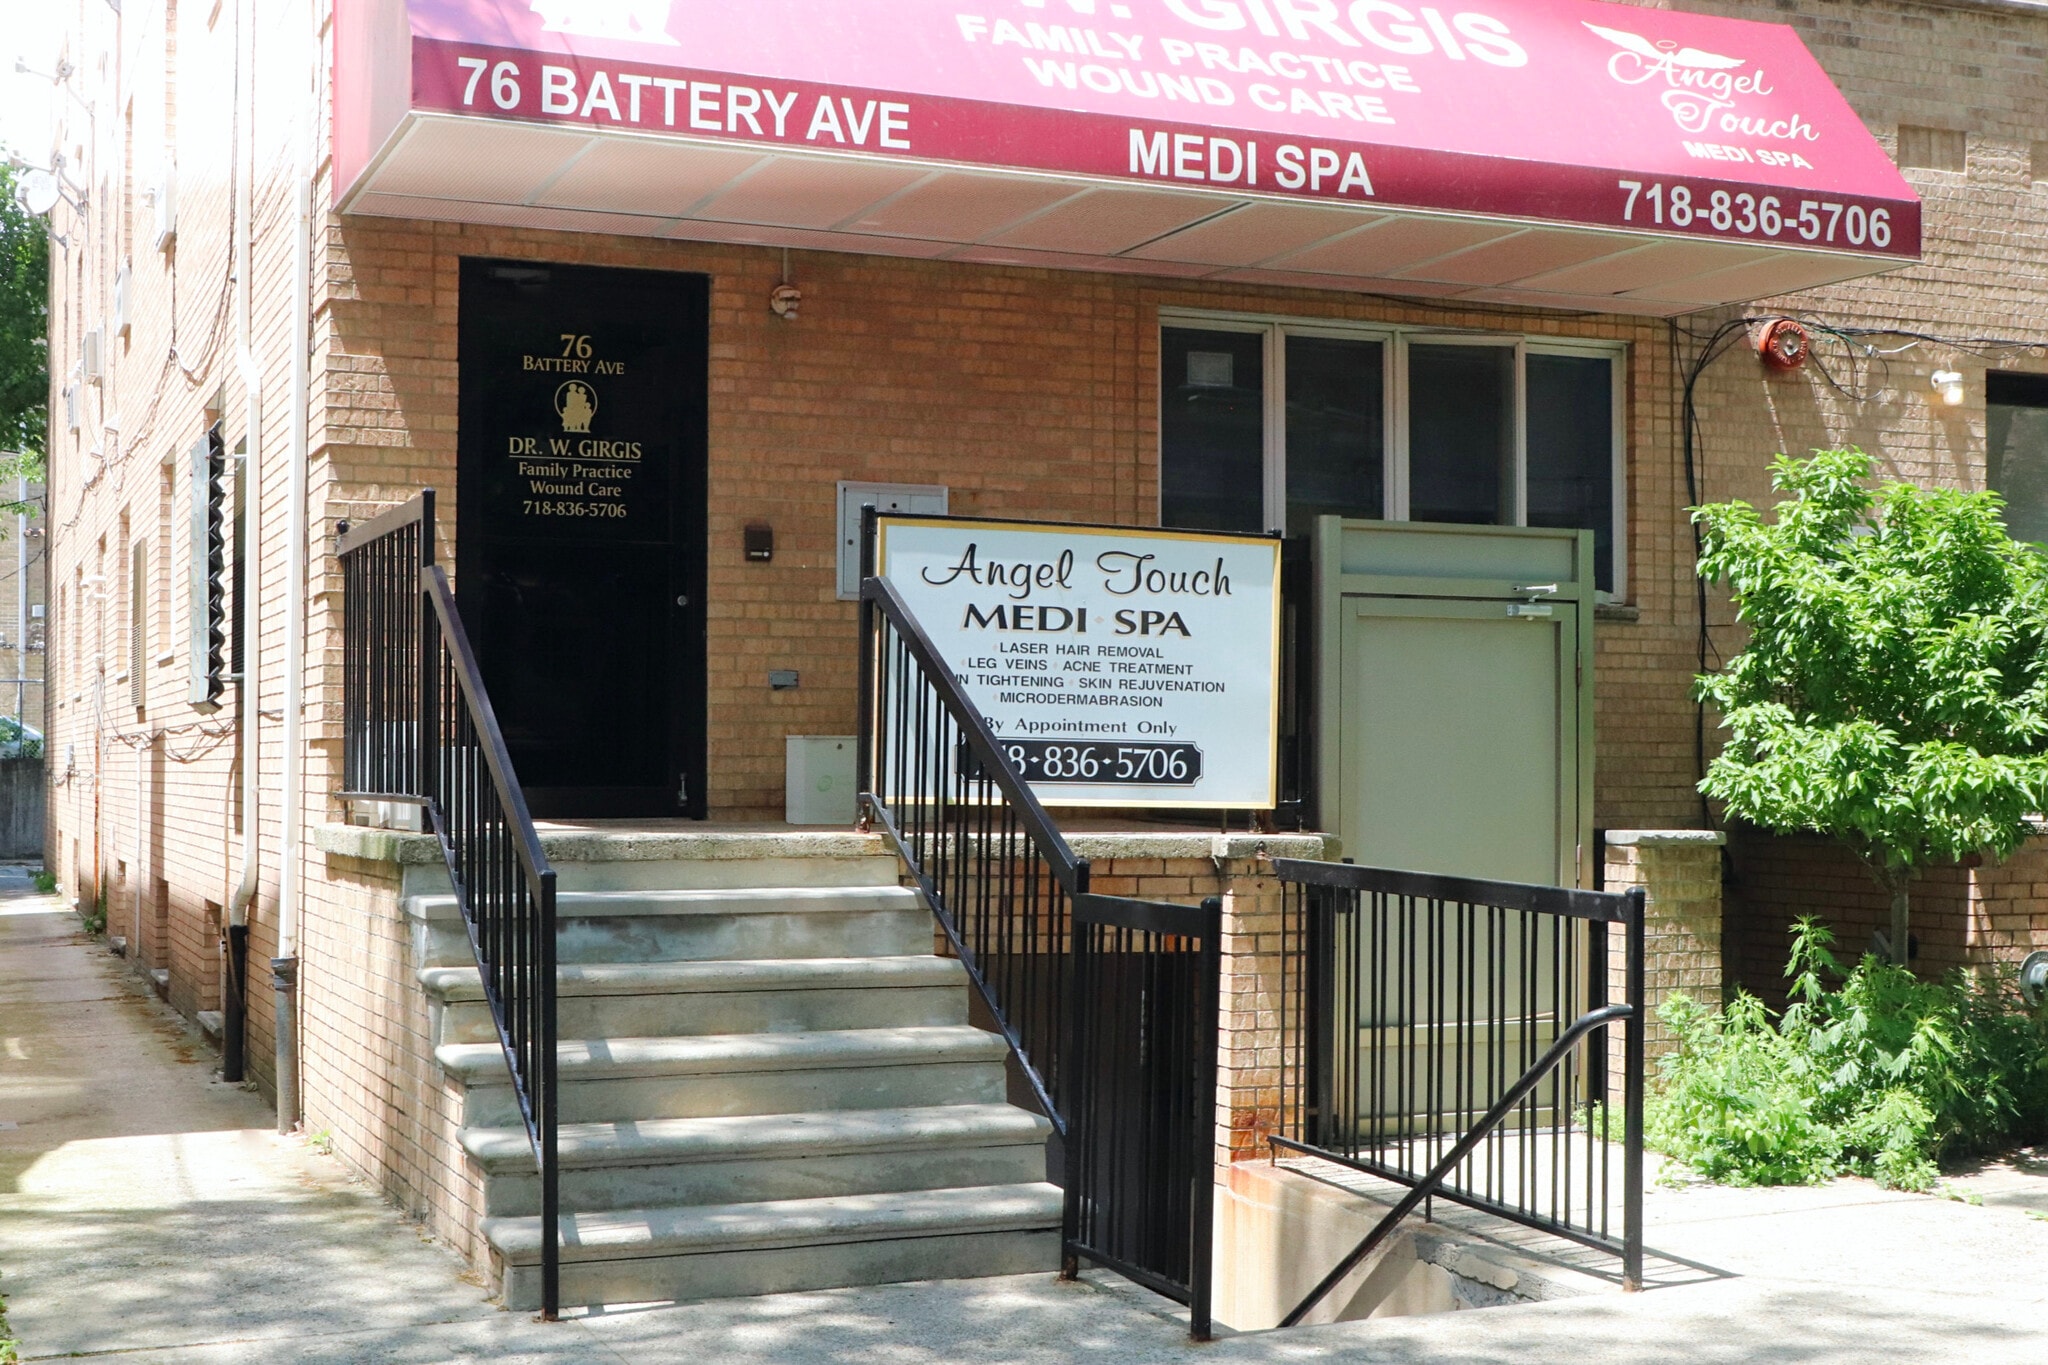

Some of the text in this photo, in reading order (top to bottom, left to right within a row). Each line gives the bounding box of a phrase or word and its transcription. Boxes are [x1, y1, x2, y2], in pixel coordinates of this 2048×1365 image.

[956, 14, 1422, 94] FAMILY PRACTICE
[1608, 50, 1774, 97] Angel
[1021, 57, 1396, 125] WOUND CARE
[457, 57, 912, 150] 76 BATTERY AVE
[1661, 89, 1820, 142] Touch
[1128, 129, 1375, 196] MEDI SPA
[1682, 141, 1814, 170] MEDI SPA
[1618, 180, 1892, 248] 718-836-5706
[560, 334, 593, 358] 76
[523, 355, 625, 375] BATTERY AVE
[508, 437, 642, 459] DR. W. GIRGIS
[518, 462, 632, 479] Family Practice
[530, 480, 622, 497] Wound Care
[523, 500, 627, 518] 718-836-5706
[922, 543, 1233, 600] Angel Touch
[962, 604, 1192, 638] MEDI SPA
[999, 642, 1164, 659] LASER HAIR REMOVAL
[968, 657, 1194, 676] LEG VEINS ACNE TREATMENT
[977, 674, 1065, 688] TIGHTENING
[1079, 677, 1113, 689] SKIN
[1119, 679, 1226, 693] REJUVENATION
[1000, 692, 1164, 708] MICRODERMABRASION
[1014, 717, 1127, 736] Appointment
[1137, 721, 1178, 737] Only
